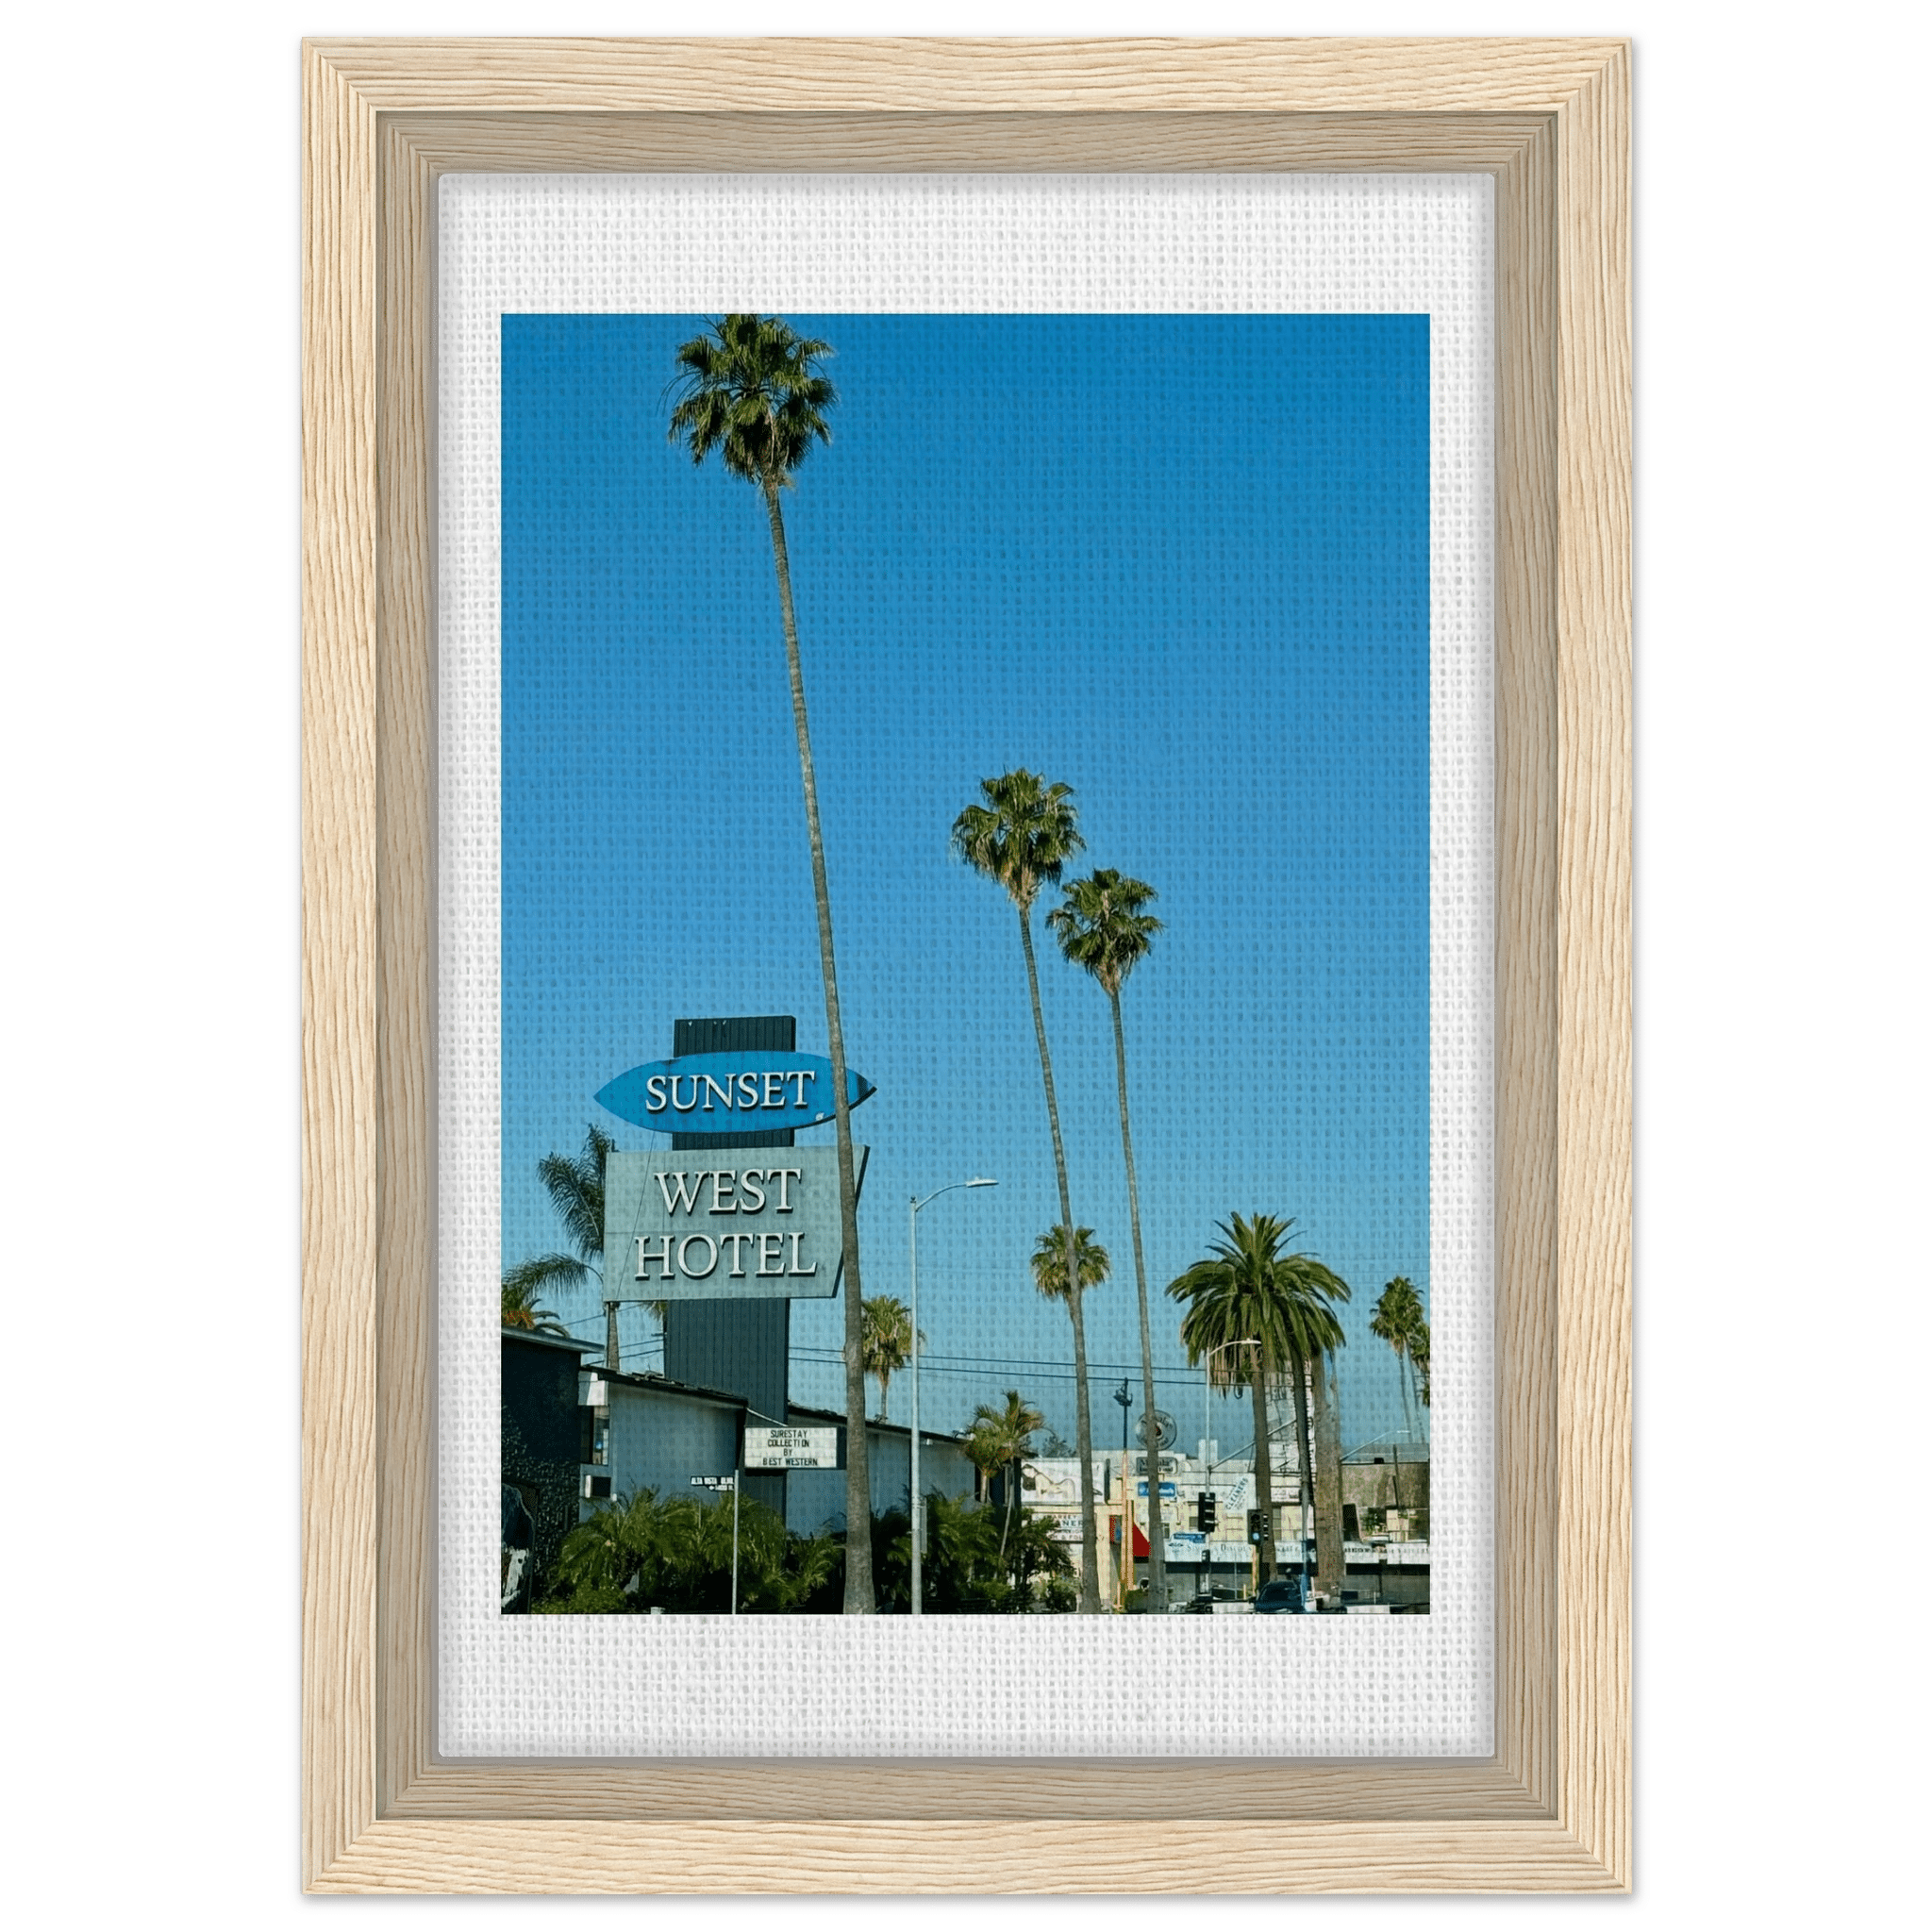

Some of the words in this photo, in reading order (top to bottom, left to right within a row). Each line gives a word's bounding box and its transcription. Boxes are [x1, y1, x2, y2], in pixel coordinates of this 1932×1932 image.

[645, 1071, 815, 1112] SUNSET
[654, 1168, 802, 1214] WEST
[634, 1232, 818, 1279] HOTEL
[770, 1429, 808, 1439] SURESTAY
[767, 1439, 809, 1447] COLLECTION
[783, 1448, 793, 1457] BY
[762, 1457, 782, 1466] BEST
[785, 1457, 818, 1466] WESTERN
